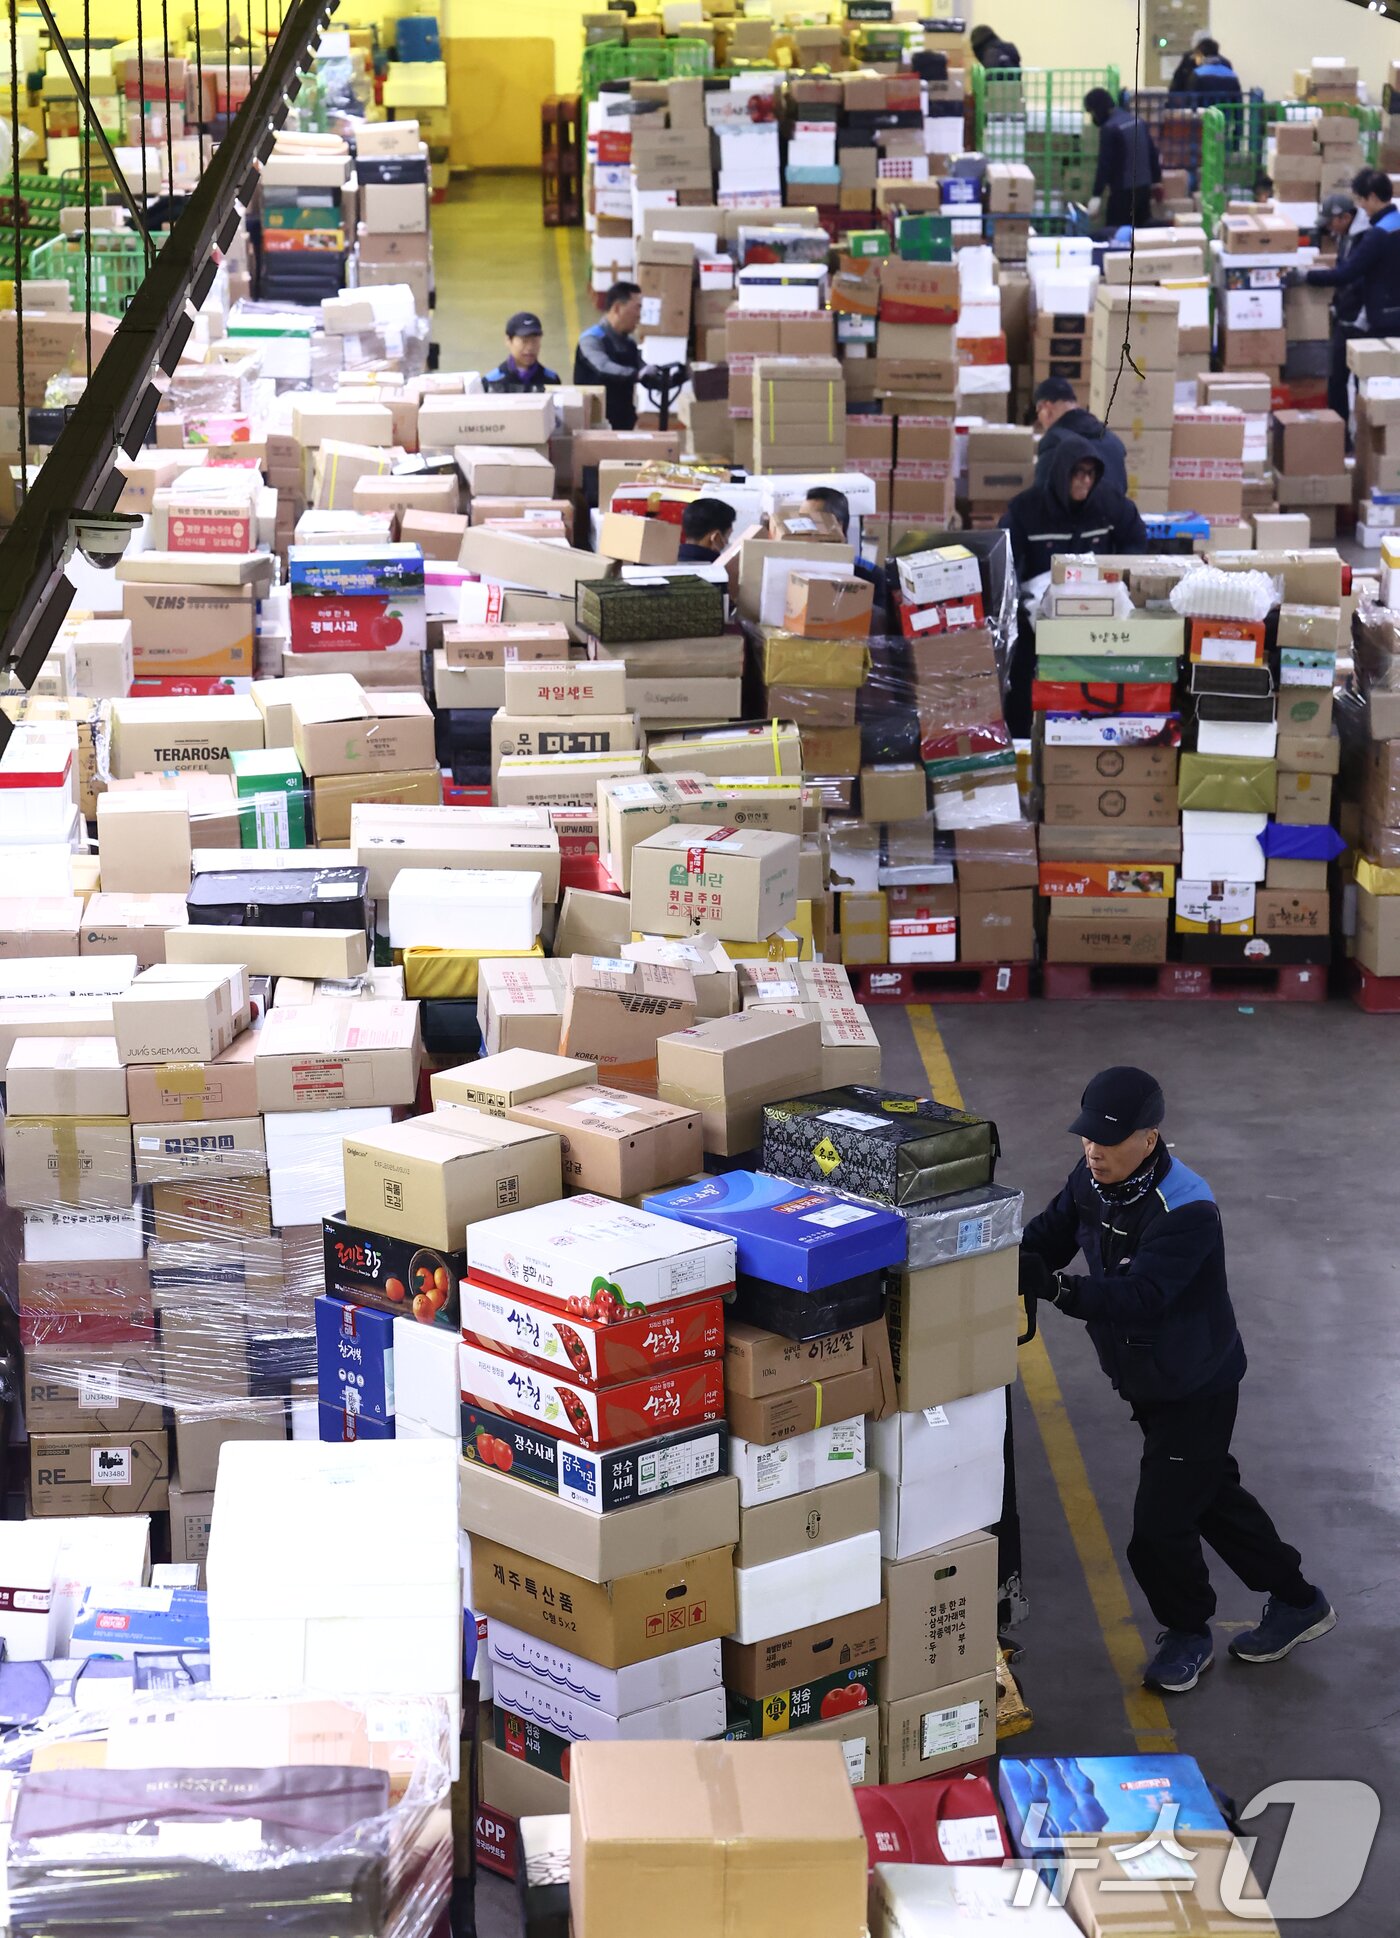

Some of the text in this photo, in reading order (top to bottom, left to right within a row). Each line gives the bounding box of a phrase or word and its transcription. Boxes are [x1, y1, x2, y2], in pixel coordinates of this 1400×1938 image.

[459, 424, 506, 433] LIMISHOP
[155, 596, 186, 610] EMS
[538, 686, 595, 700] 과일세트
[154, 747, 230, 762] TERAROSA
[1066, 881, 1084, 895] 쇼핑
[669, 890, 723, 906] 취급주의
[574, 1052, 618, 1063] KOREA POST
[565, 1159, 583, 1176] 감귤
[499, 1178, 517, 1192] 곡물
[696, 1184, 720, 1201] 쇼핑
[386, 1195, 402, 1208] 도감
[499, 1192, 517, 1207] 도감
[334, 1240, 382, 1279] 레드향
[522, 1263, 554, 1288] 봉화 사과
[648, 1321, 661, 1330] 지리산
[808, 1331, 855, 1359] 이천쌀
[704, 1349, 716, 1358] 5kg
[578, 1374, 589, 1385] 5kg
[762, 1368, 777, 1378] 10kg
[31, 1385, 60, 1401] RE
[649, 1383, 662, 1392] 지리산
[704, 1411, 716, 1420] 5kg
[514, 1434, 555, 1464] 장수사과
[579, 1437, 590, 1449] 5kg
[97, 1470, 125, 1478] UN3480
[612, 1459, 634, 1476] 장수
[37, 1468, 67, 1485] RE
[611, 1474, 634, 1492] 사과
[493, 1563, 573, 1614] 제주특산품
[929, 1597, 966, 1617] 전통한과
[542, 1610, 557, 1625] C형
[929, 1609, 966, 1629] 삼색가래떡
[929, 1622, 966, 1640] 각종엑기스
[766, 1639, 793, 1654] 특별한 당신
[791, 1688, 811, 1704] 청송
[790, 1702, 812, 1718] 사과
[525, 1721, 541, 1738] 청송
[525, 1737, 541, 1754] 사과
[476, 1815, 506, 1843] KPP
